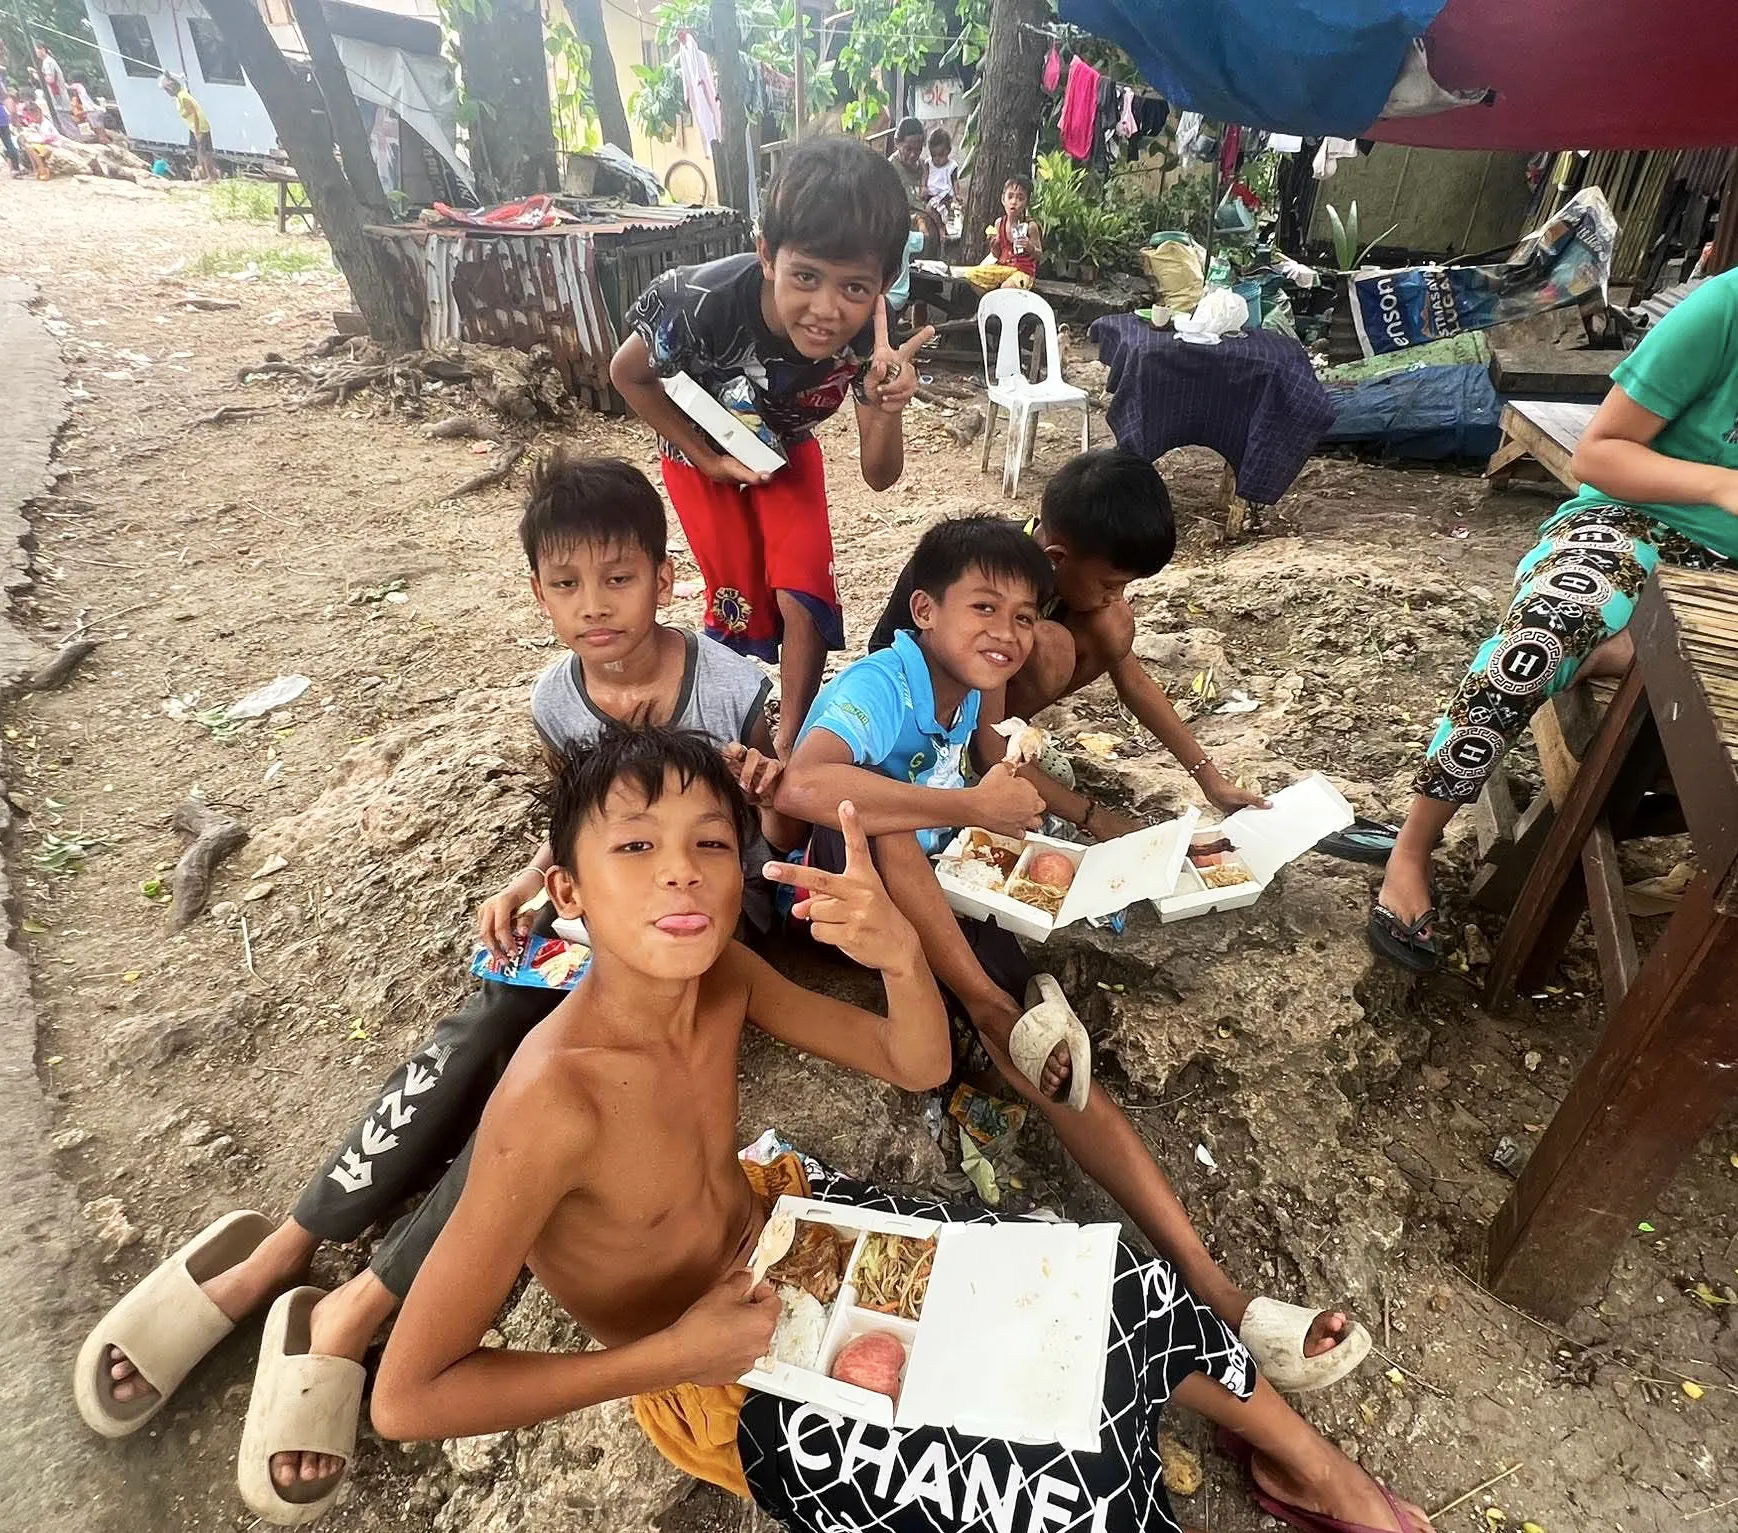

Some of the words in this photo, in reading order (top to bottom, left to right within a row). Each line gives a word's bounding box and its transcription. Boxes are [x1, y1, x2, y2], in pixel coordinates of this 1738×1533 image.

[1558, 575, 1591, 591] H
[1508, 650, 1539, 677] H
[1459, 743, 1487, 763] H
